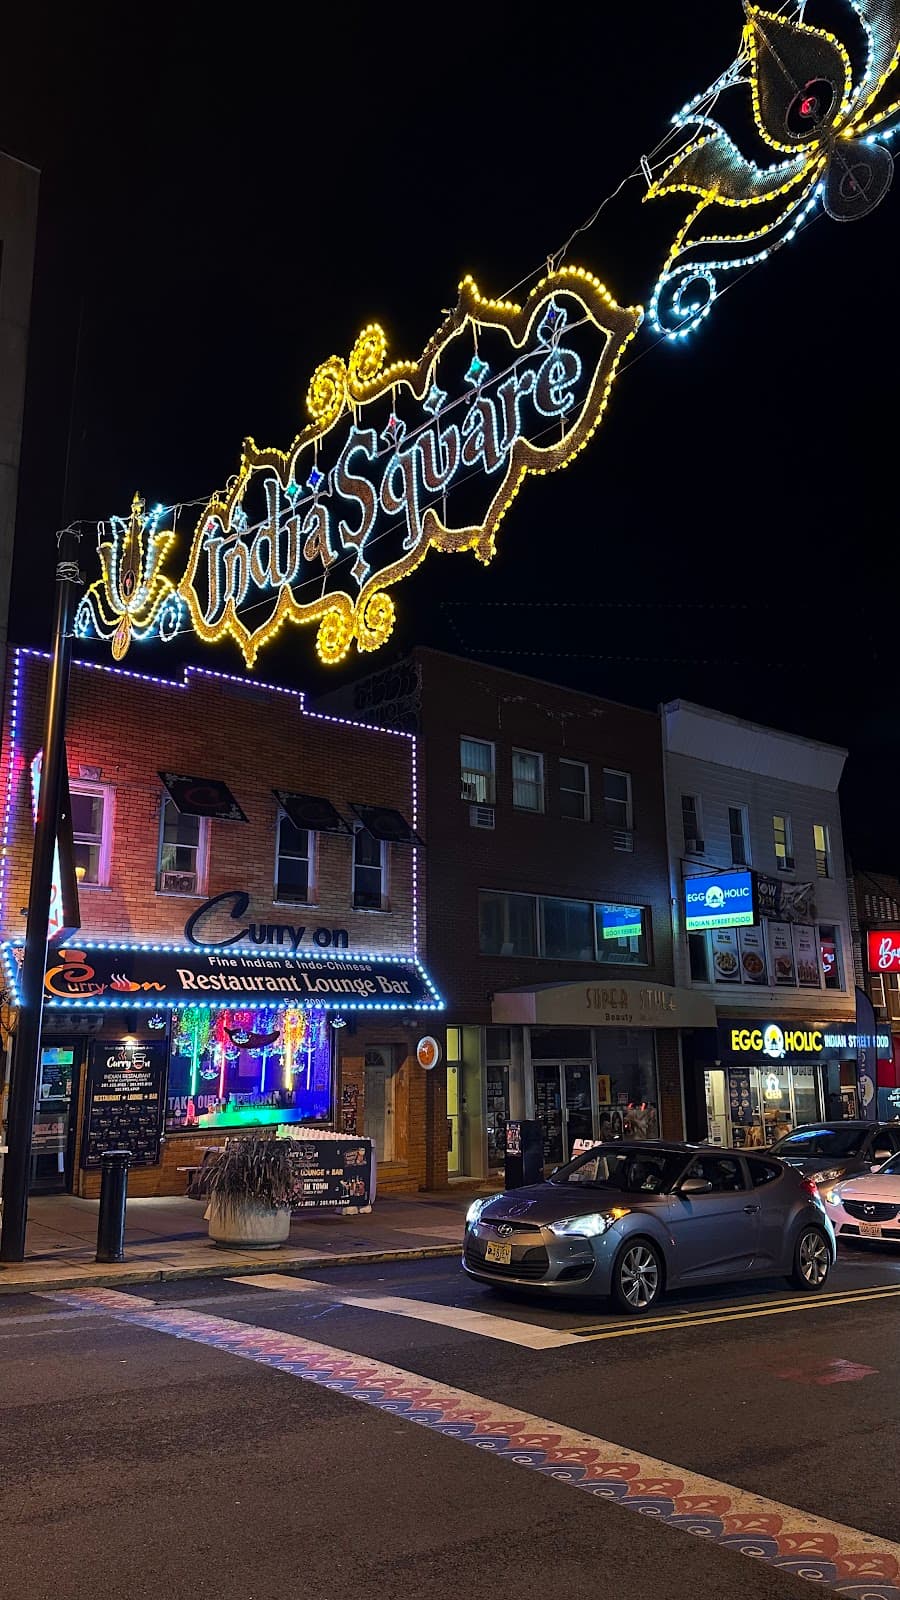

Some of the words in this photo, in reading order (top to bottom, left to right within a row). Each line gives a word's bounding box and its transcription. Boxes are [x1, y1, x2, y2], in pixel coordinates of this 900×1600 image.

[334, 348, 582, 562] Square
[687, 892, 705, 902] EGG
[725, 887, 750, 898] HOLIC
[184, 891, 305, 952] Curry
[312, 926, 349, 948] on
[688, 919, 710, 927] INDIAN
[711, 918, 730, 926] STREET
[208, 956, 237, 968] Fine
[241, 958, 281, 969] Indian
[285, 960, 294, 969] &
[296, 960, 372, 972] Indo-Chinese
[44, 963, 107, 998] Curry
[176, 968, 301, 992] Restaurant
[301, 973, 379, 997] Lounge
[375, 976, 411, 994] Bar
[605, 1013, 633, 1023] Beauty
[731, 1029, 762, 1051] EGG
[785, 1031, 823, 1052] HOLIC
[824, 1035, 847, 1048] INDIAN
